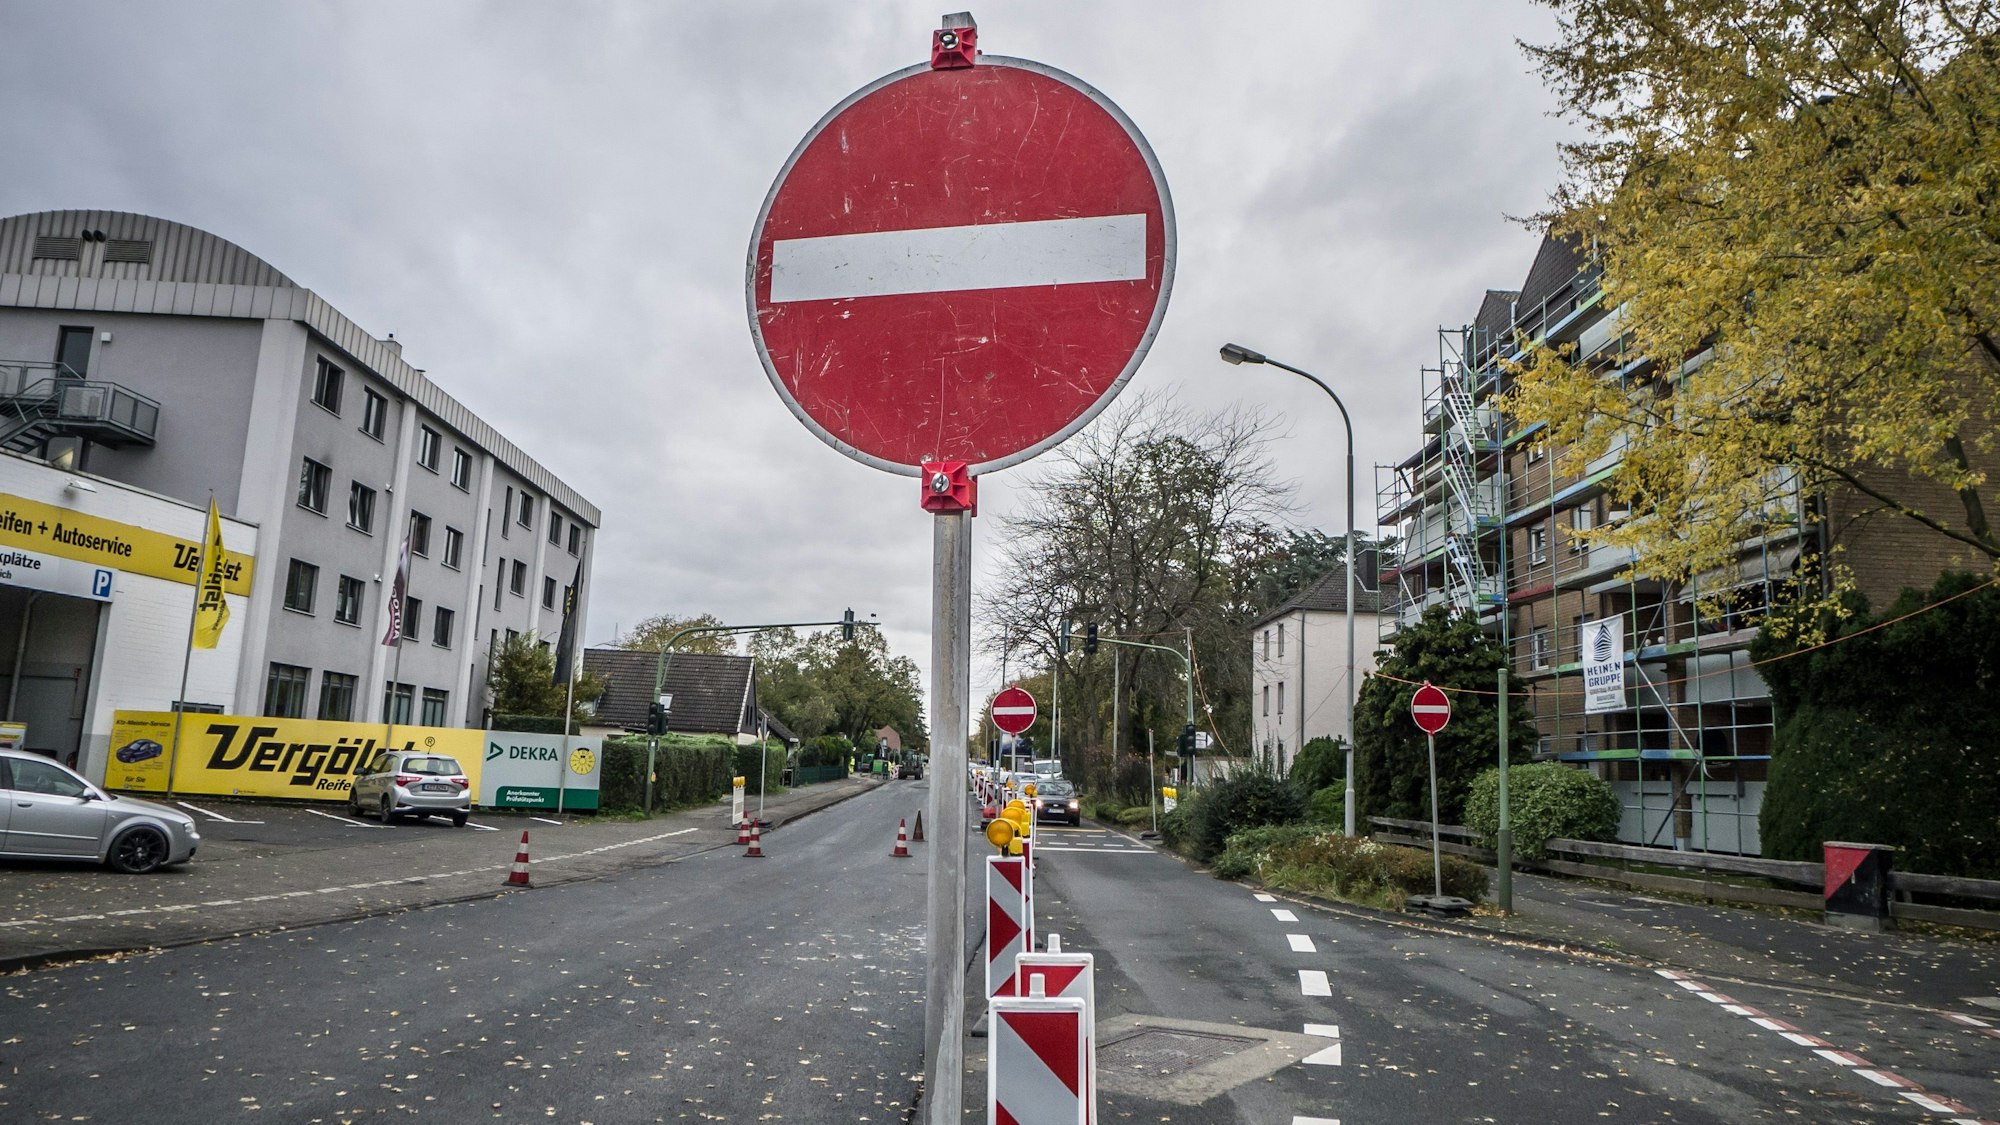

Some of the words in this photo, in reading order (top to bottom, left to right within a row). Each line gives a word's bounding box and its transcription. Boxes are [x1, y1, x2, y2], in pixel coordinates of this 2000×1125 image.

[38, 521, 48, 534] +
[52, 523, 132, 557] Autoservice
[96, 571, 110, 595] P
[1587, 661, 1621, 676] HEINEN
[1588, 673, 1621, 687] GRUPPE
[206, 724, 420, 786] Vergöl
[509, 745, 558, 761] DEKRA
